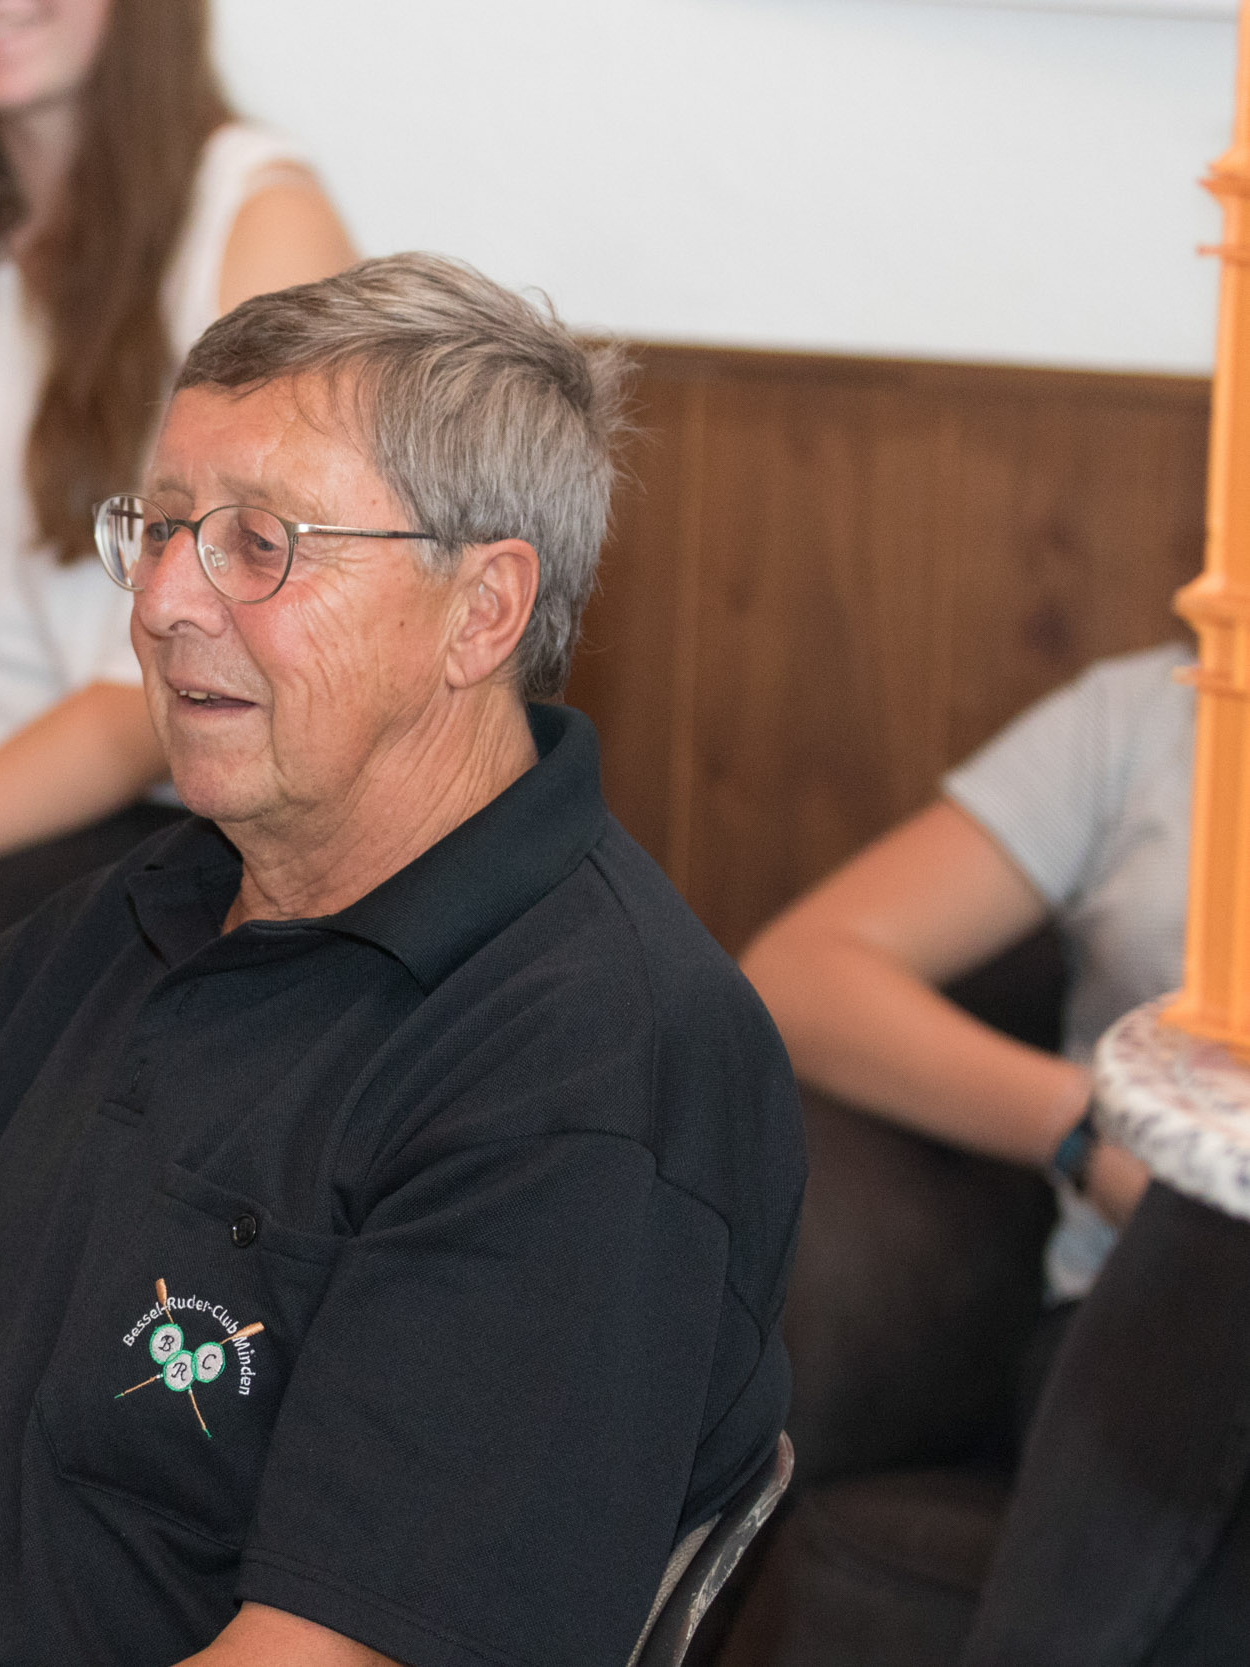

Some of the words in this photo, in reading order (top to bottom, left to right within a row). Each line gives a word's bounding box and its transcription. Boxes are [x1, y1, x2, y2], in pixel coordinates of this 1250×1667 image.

[158, 1335, 175, 1352] B
[171, 1362, 188, 1382] R
[202, 1353, 217, 1370] C
[231, 1336, 256, 1396] Minden
